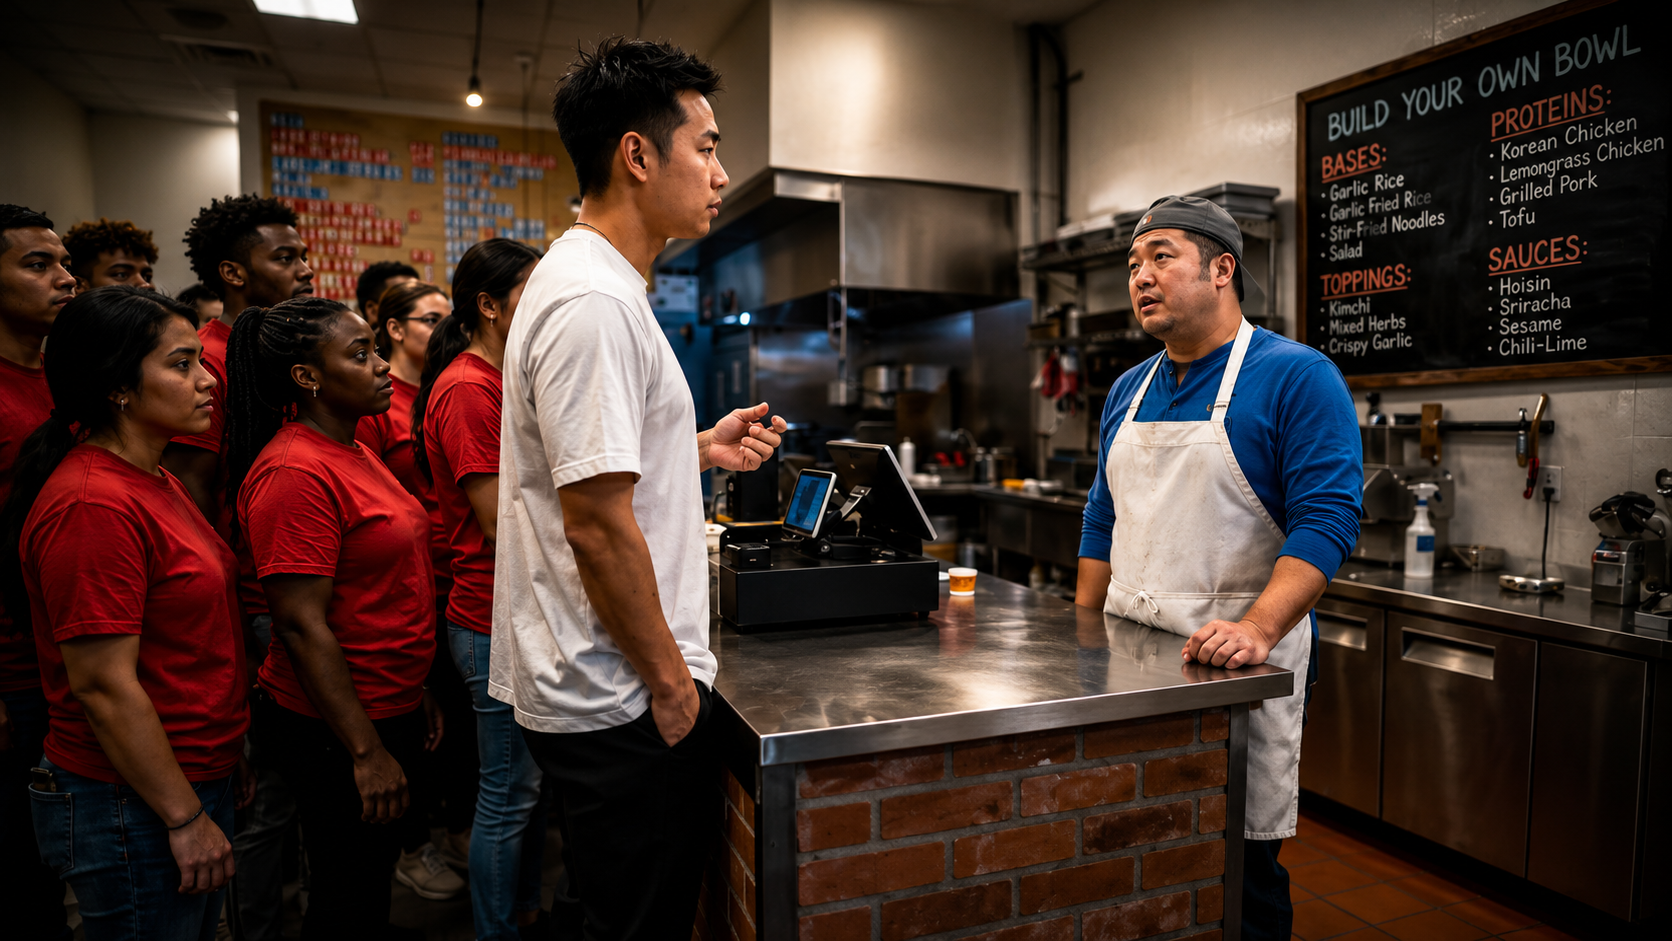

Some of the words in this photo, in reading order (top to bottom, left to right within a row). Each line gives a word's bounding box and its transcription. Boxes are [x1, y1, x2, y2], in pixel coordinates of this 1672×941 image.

[1328, 99, 1389, 141] BUILD
[1401, 76, 1463, 120] YOUR
[1478, 51, 1540, 98] OWN
[1554, 24, 1641, 77] BOWL
[1491, 84, 1612, 138] PROTEINS:
[1501, 133, 1558, 162] Korean
[1564, 117, 1638, 145] Chicken
[1321, 143, 1387, 179] BASES:
[1500, 151, 1591, 184] Lemongrass
[1596, 135, 1664, 162] Chicken
[1329, 178, 1369, 202] Garlic
[1374, 172, 1404, 192] Rice
[1499, 176, 1553, 206] Grilled
[1559, 171, 1598, 194] Pork
[1329, 199, 1365, 222] Garlic
[1369, 194, 1399, 213] Fried
[1404, 190, 1432, 207] Rice
[1499, 207, 1536, 229] Tofu
[1329, 221, 1388, 242] Stir-Fried
[1391, 210, 1445, 232] Noodles
[1329, 241, 1363, 262] Salad
[1488, 234, 1588, 272] SAUCES:
[1320, 263, 1411, 296] TOPPINGS:
[1499, 274, 1551, 296] Hoisin
[1329, 297, 1371, 317] Kimchi
[1499, 293, 1571, 316] Sriracha
[1329, 317, 1364, 335] Mixed
[1368, 313, 1406, 332] Herbs
[1499, 318, 1562, 336] Sesame
[1329, 336, 1369, 356] Crispy
[1372, 333, 1412, 351] Garlic
[1499, 334, 1588, 356] Chili-Lime
